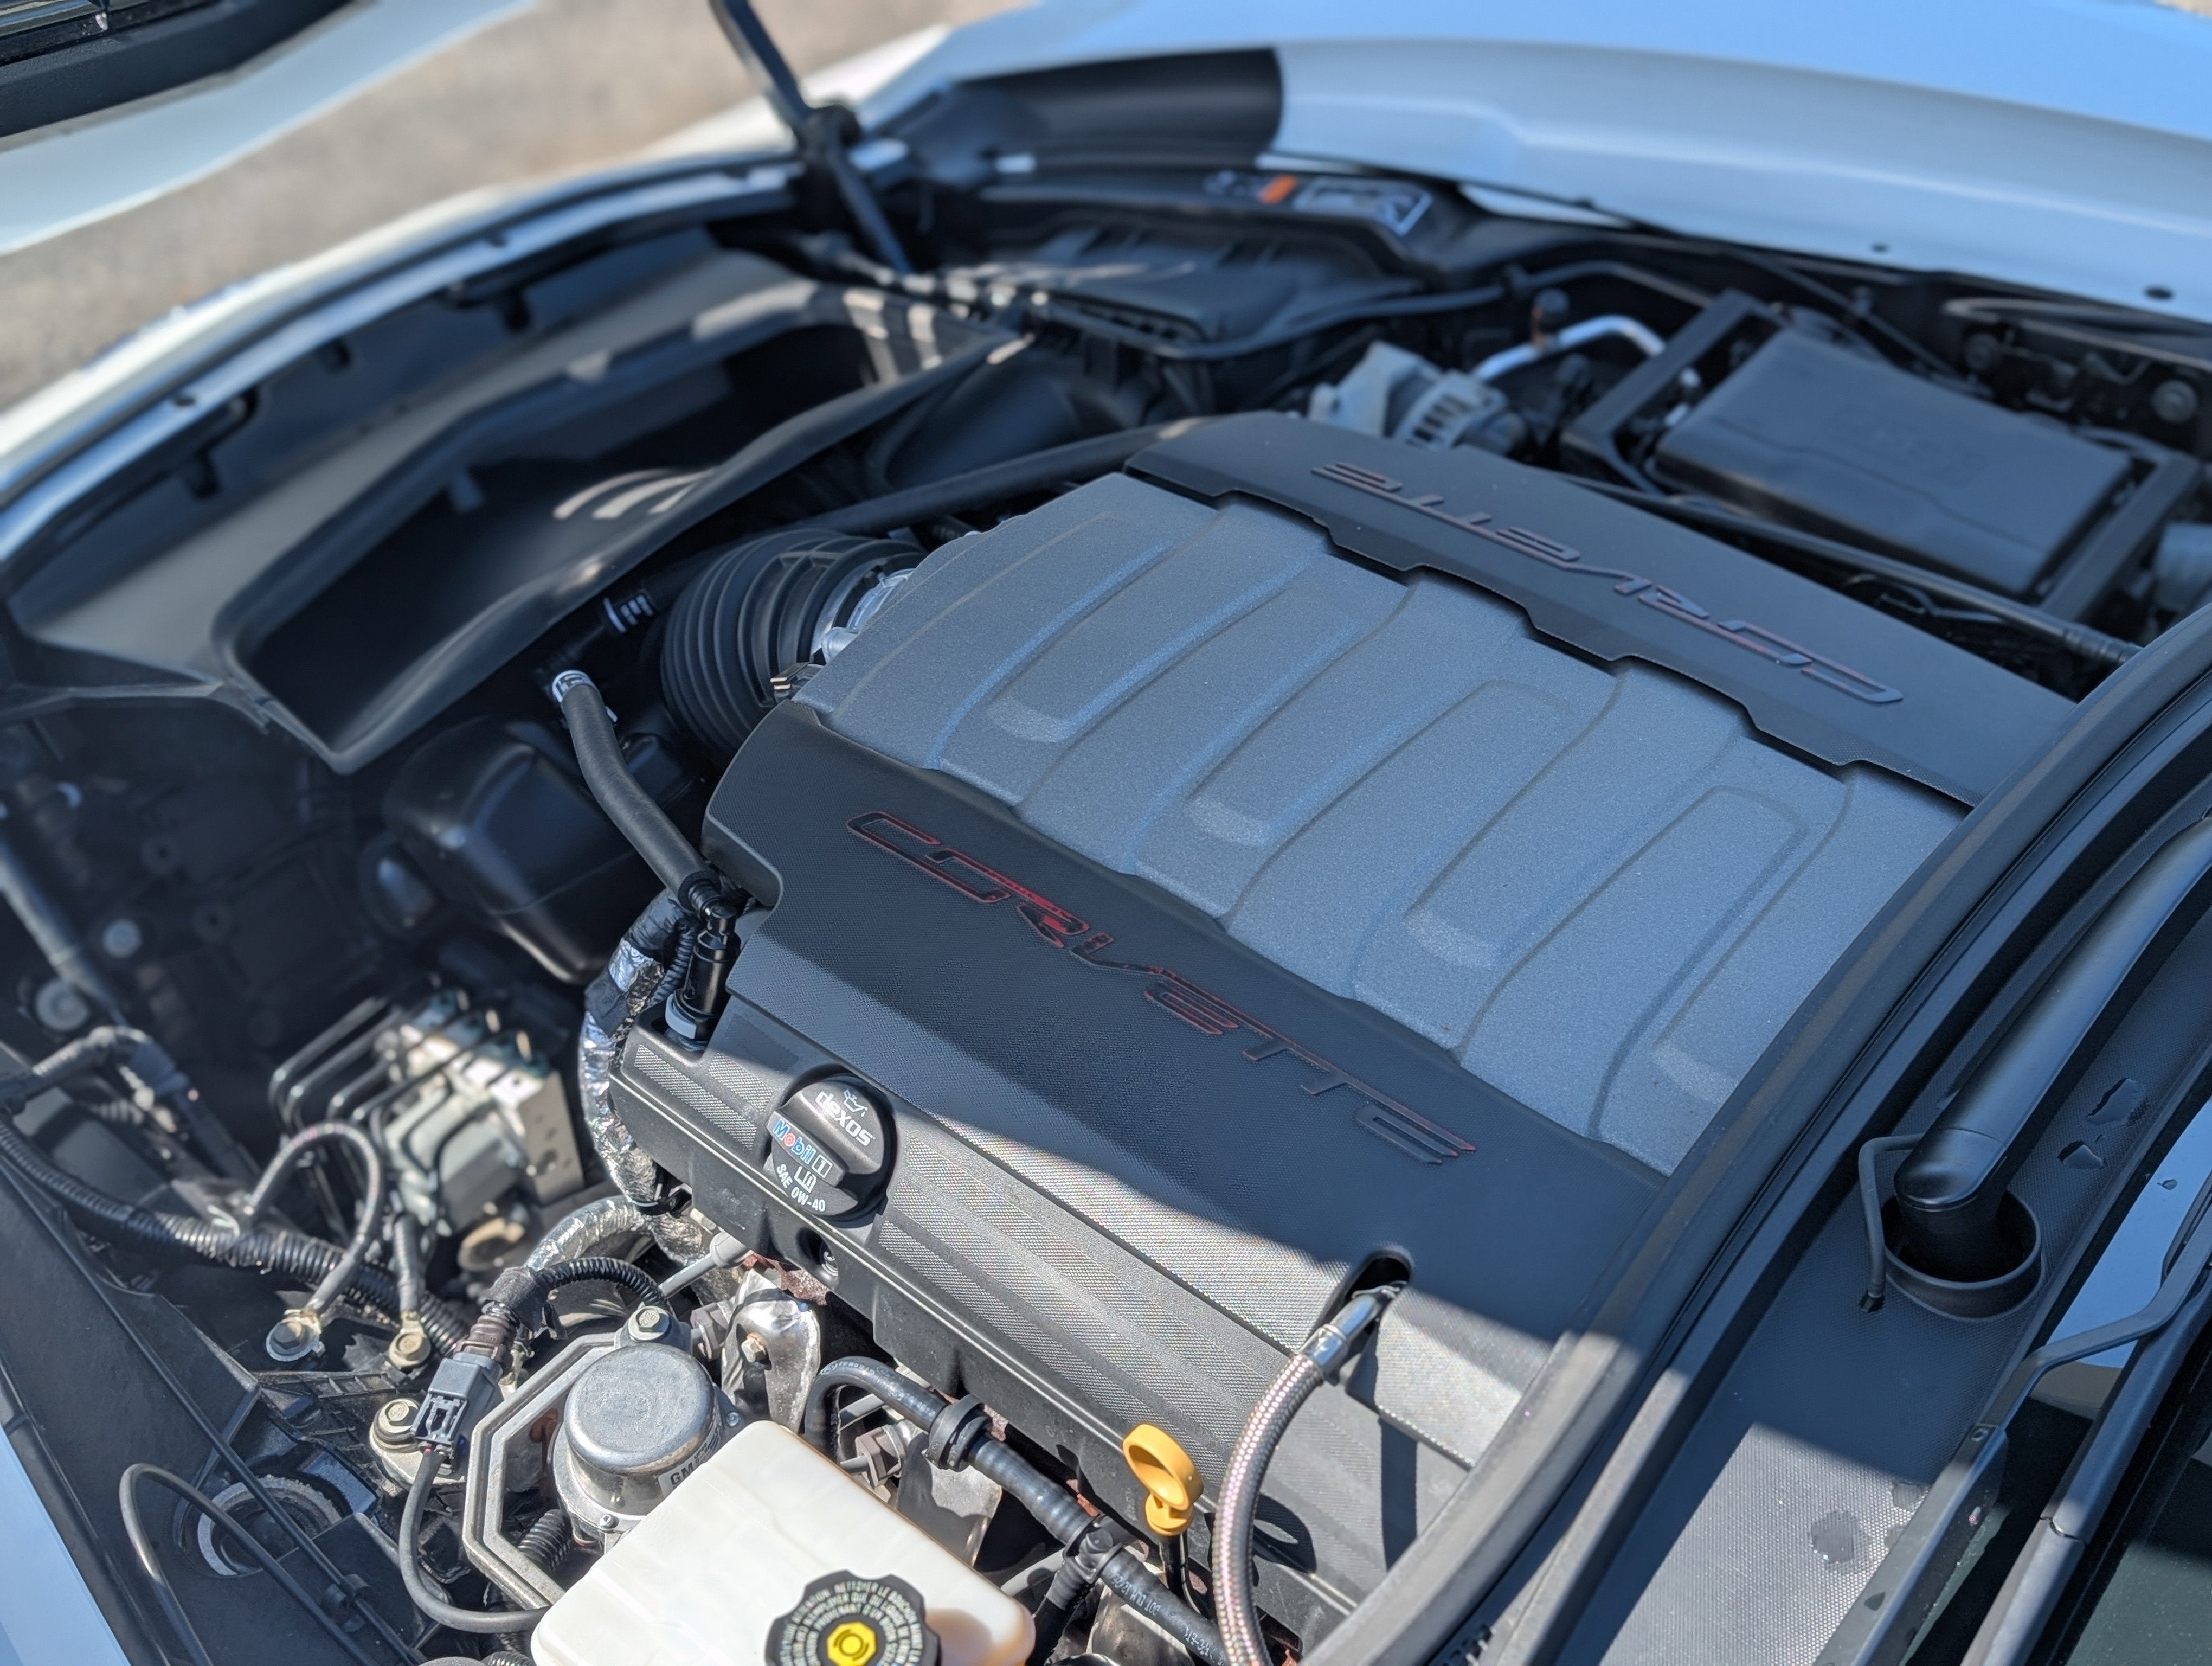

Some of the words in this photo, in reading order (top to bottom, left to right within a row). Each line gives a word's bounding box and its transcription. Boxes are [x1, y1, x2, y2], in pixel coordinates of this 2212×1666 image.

[1311, 462, 1903, 704] CORVETTE
[846, 811, 1477, 1164] CORVETTE
[771, 1118, 816, 1165] Mobil
[815, 1091, 873, 1146] dexos
[776, 1163, 793, 1188] SAE
[790, 1187, 826, 1212] 0W-40
[670, 1462, 694, 1485] GM
